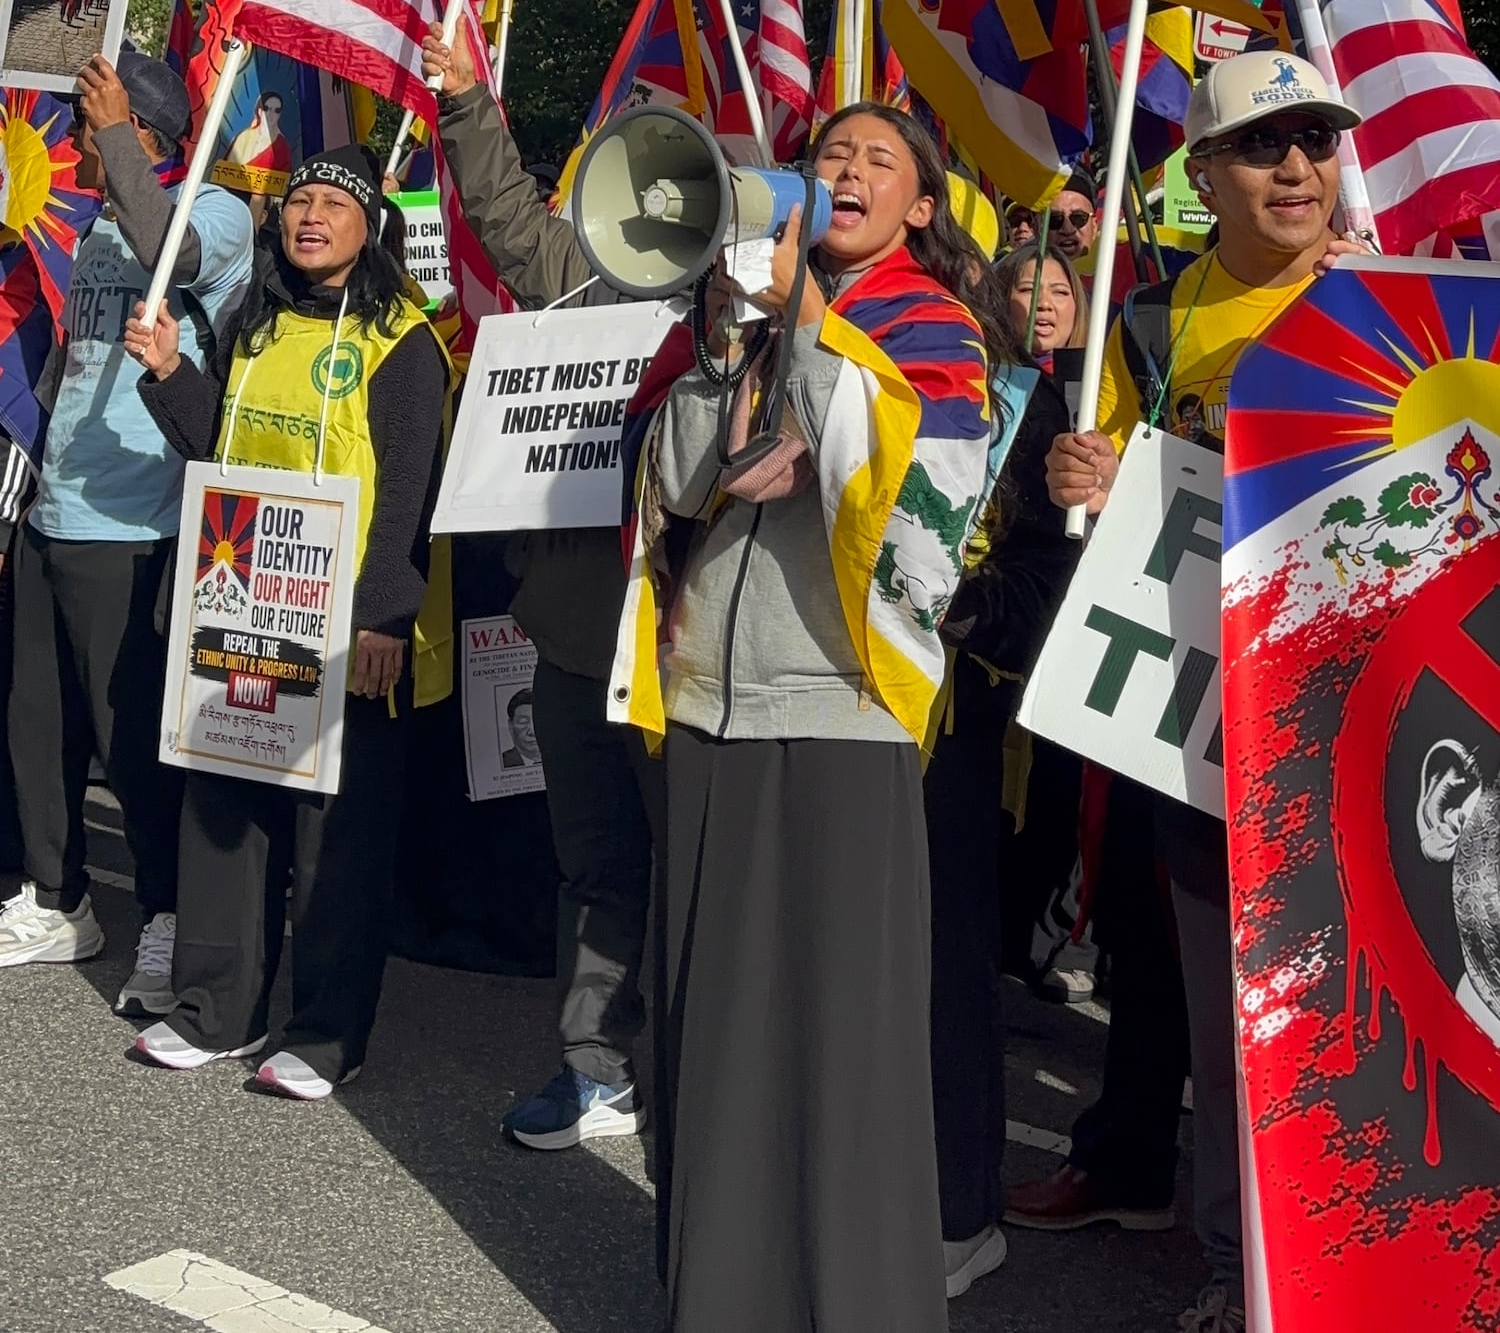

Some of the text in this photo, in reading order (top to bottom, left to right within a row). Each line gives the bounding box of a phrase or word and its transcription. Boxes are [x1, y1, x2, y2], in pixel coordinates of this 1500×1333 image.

[1202, 45, 1211, 55] IF
[1252, 93, 1316, 104] RODEO
[290, 169, 370, 204] of China
[312, 162, 374, 194] never
[407, 266, 439, 282] SIDE
[70, 286, 143, 343] IBET
[487, 365, 550, 397] TIBET
[551, 359, 621, 392] MUST
[501, 397, 632, 435] INDEPENDE
[524, 439, 621, 474] NATION!
[261, 505, 304, 541] OUR
[257, 539, 334, 577] IDENTITY
[253, 572, 330, 610] OUR RIGHT
[251, 605, 326, 639] OUR FUTURE
[223, 632, 281, 659] REPEAL THE
[196, 649, 318, 683] ETHNIC UNITY & PROGRESS LAW
[473, 667, 510, 677] GENOCIDE
[233, 675, 272, 707] NOW!
[1084, 604, 1222, 766] TI
